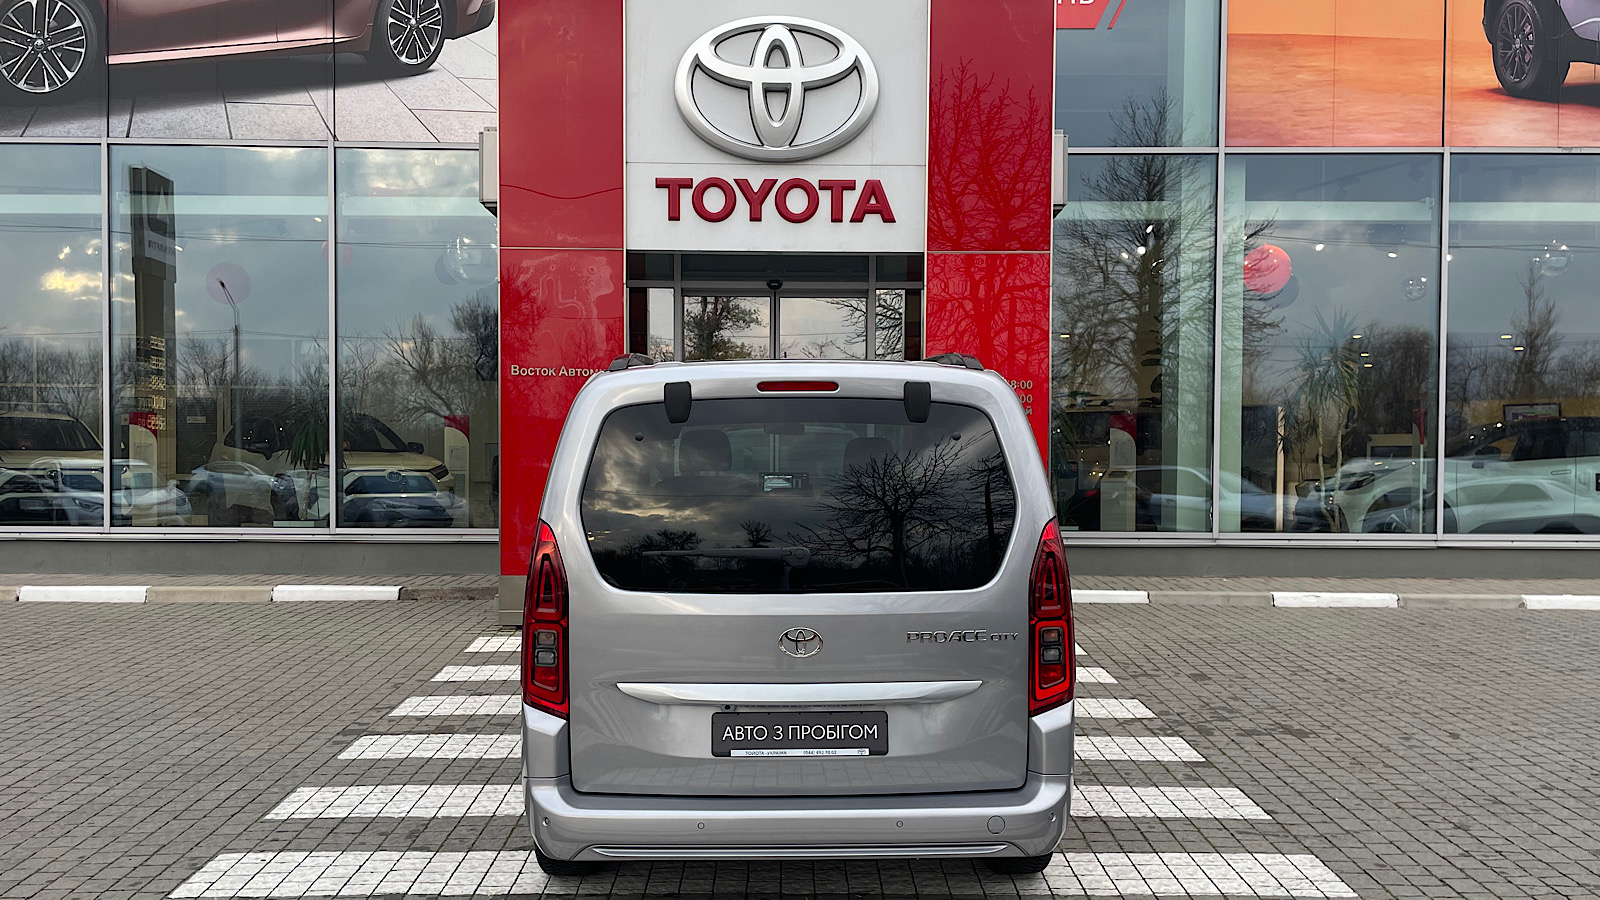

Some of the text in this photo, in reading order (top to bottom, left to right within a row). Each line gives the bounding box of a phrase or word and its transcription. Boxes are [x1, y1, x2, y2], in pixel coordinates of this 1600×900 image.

[655, 177, 896, 223] TOYOTA
[1008, 380, 1033, 389] 8:00
[906, 630, 1018, 643] PROACE CITY
[722, 725, 768, 741] АВТО
[788, 724, 878, 740] ПРОБІГОМ
